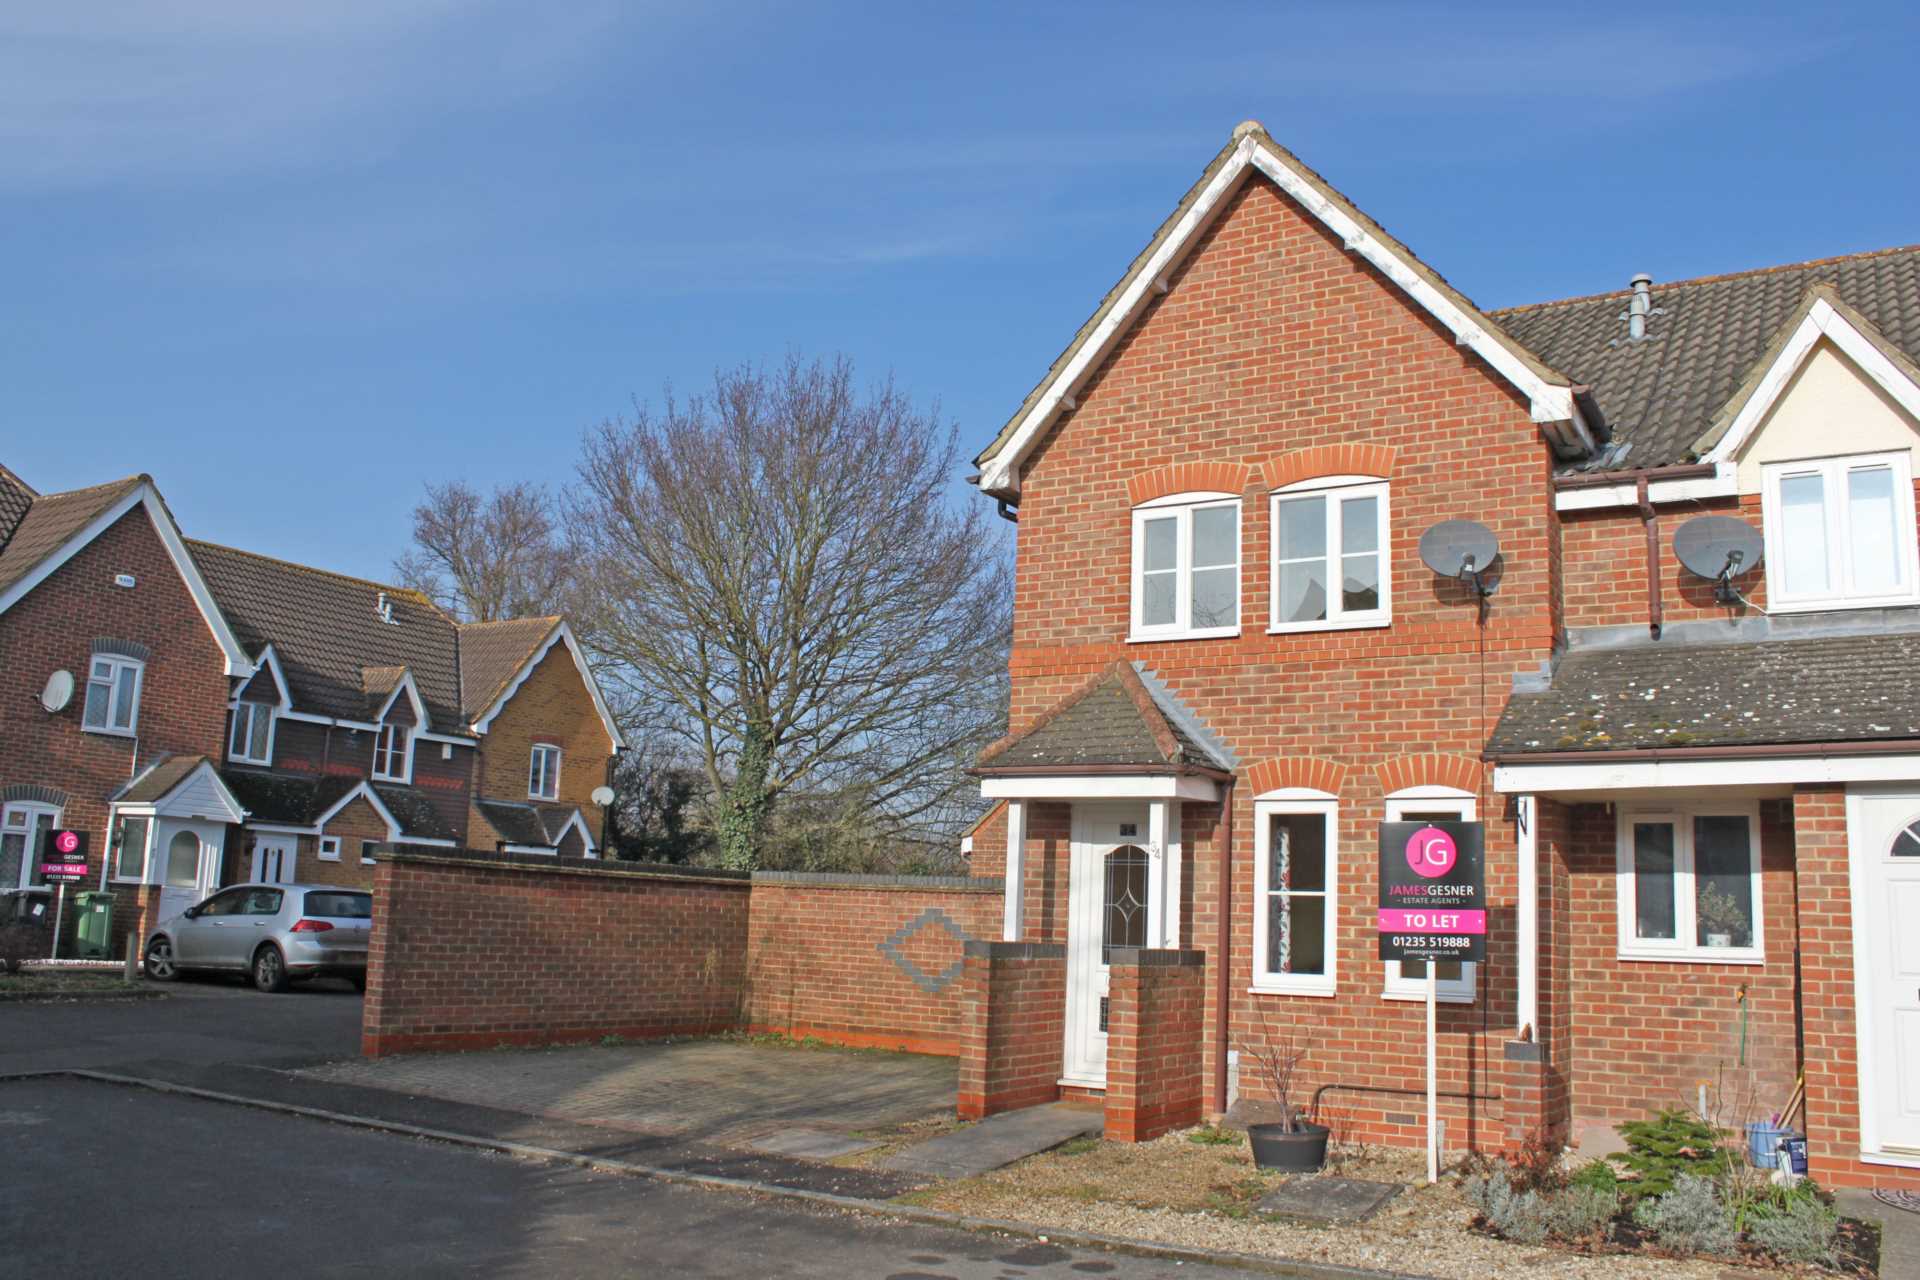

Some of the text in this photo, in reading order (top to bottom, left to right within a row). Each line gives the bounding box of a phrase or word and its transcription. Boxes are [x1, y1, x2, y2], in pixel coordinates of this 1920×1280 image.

[1414, 838, 1448, 866] JG
[1403, 914, 1460, 928] TO LET
[1392, 936, 1471, 948] 01235 519888
